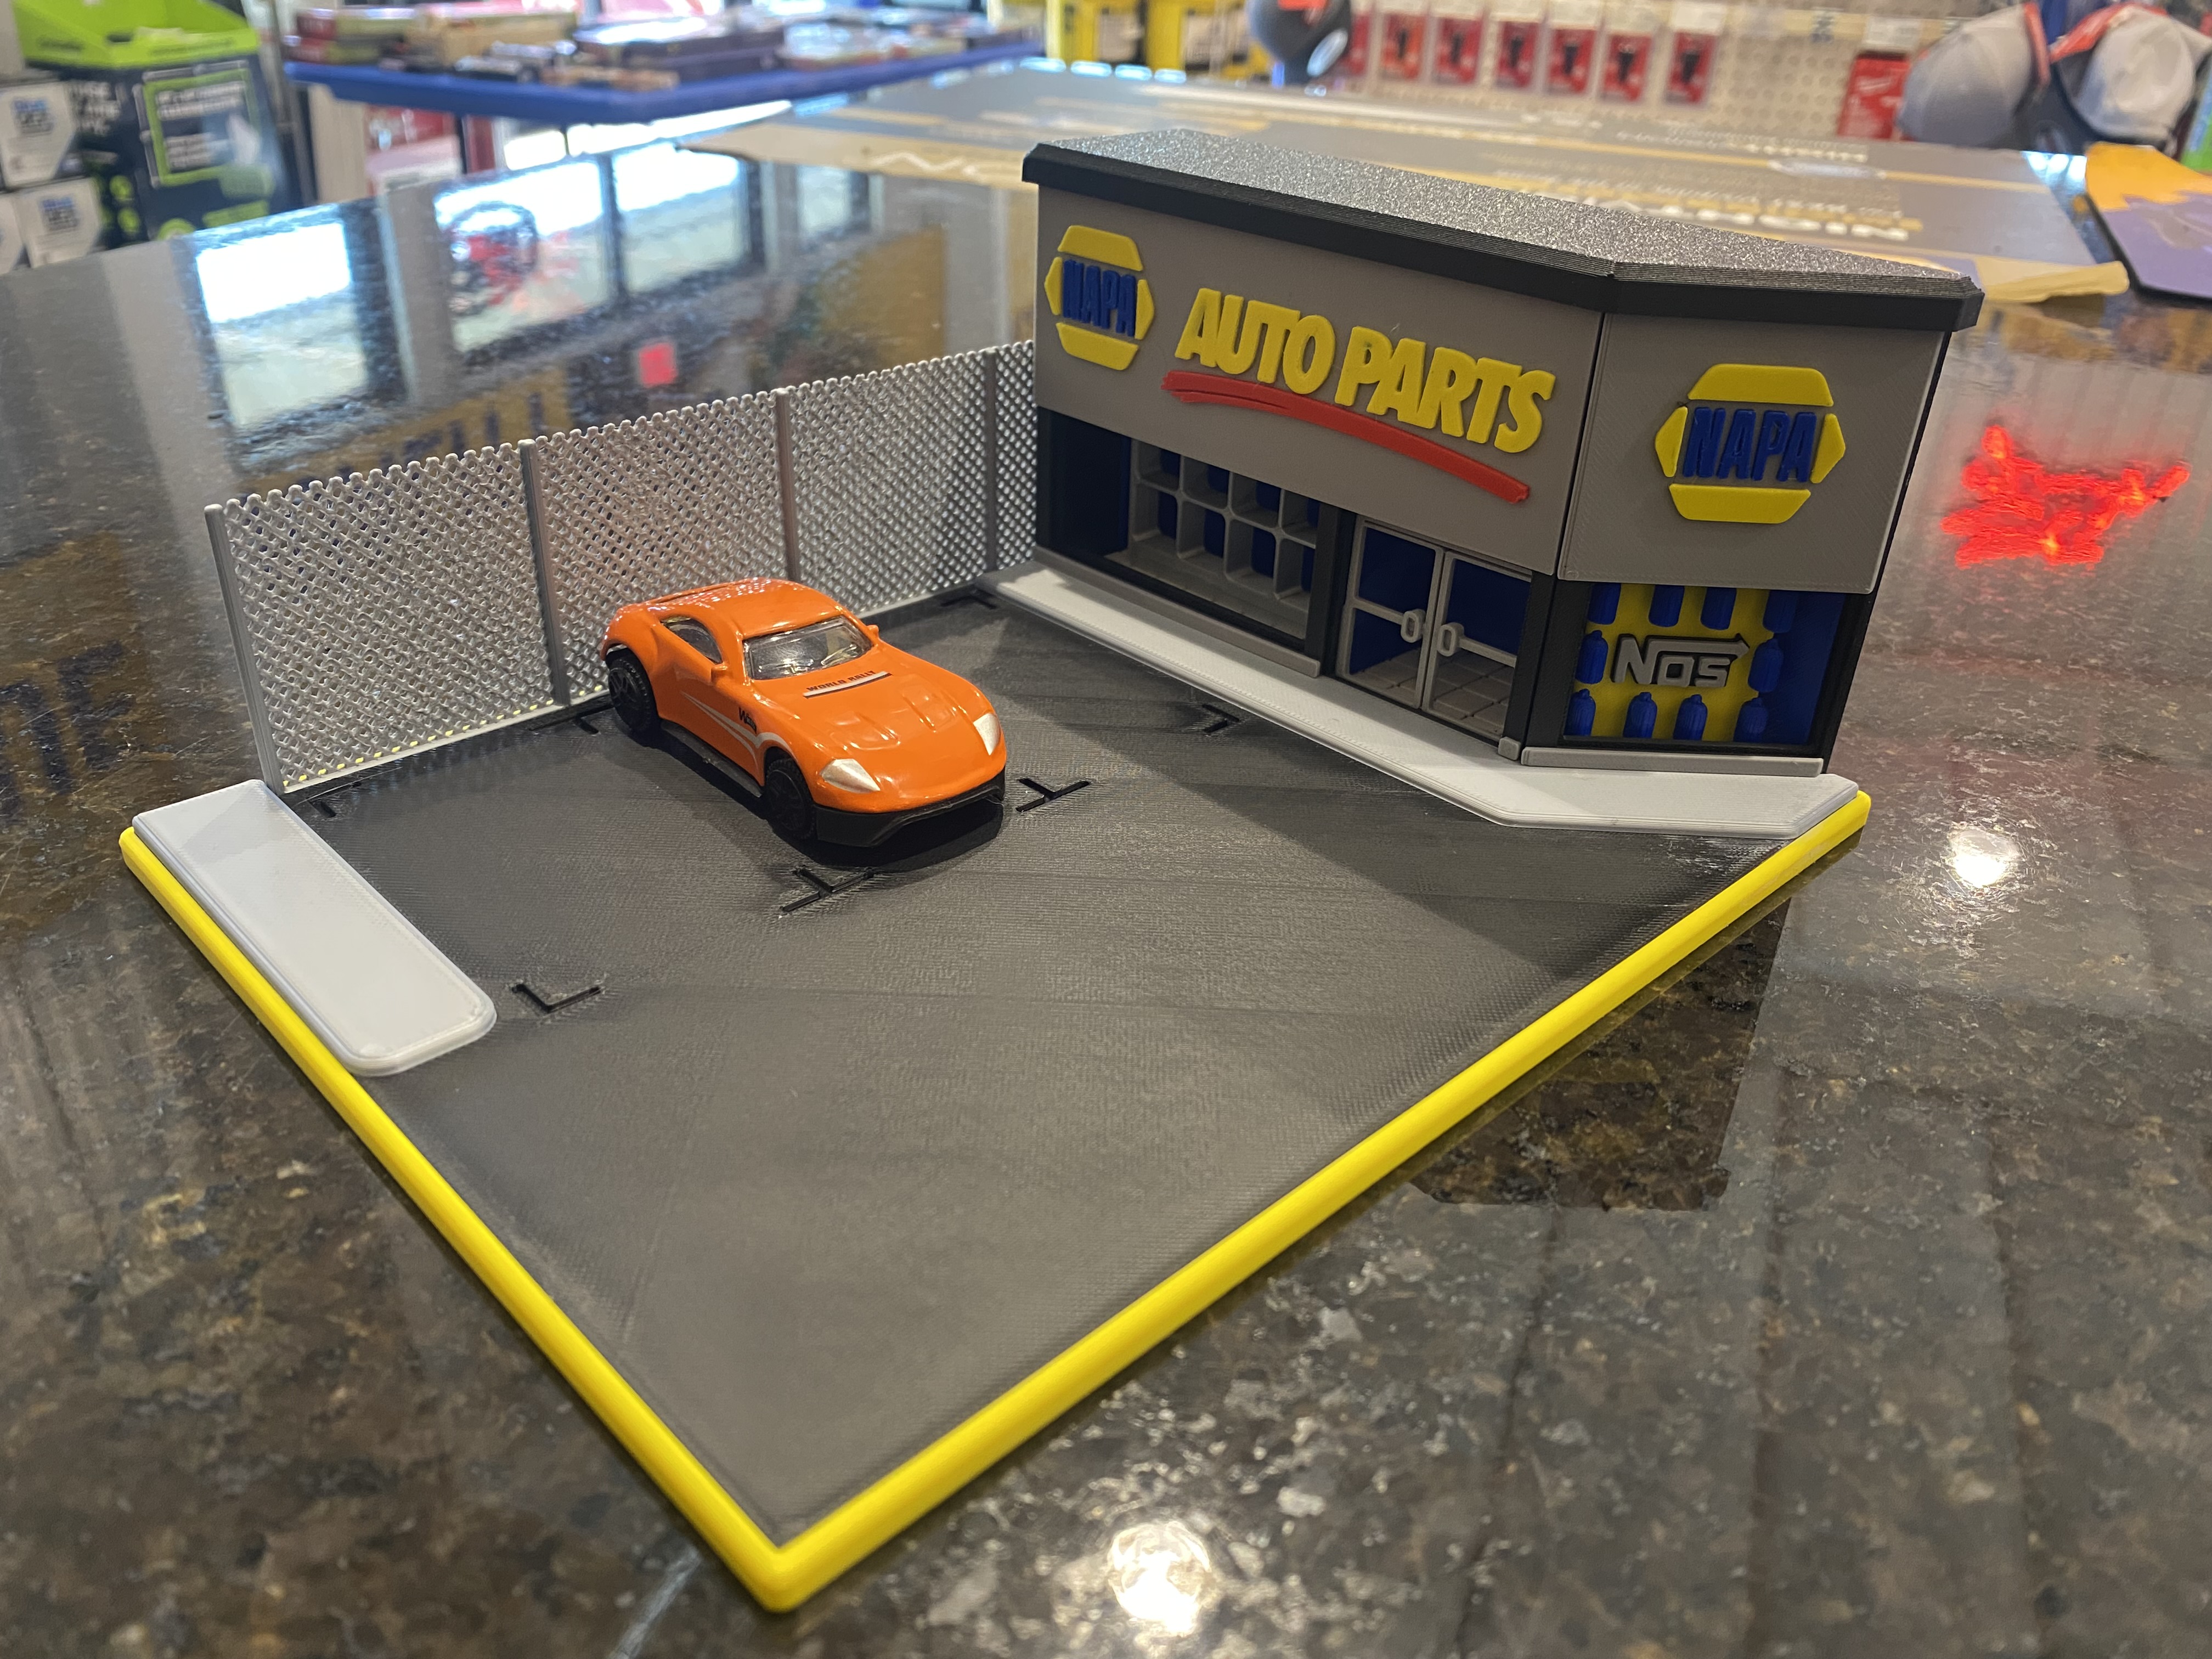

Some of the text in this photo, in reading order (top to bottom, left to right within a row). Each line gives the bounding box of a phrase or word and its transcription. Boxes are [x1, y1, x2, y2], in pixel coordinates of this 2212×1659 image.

[1063, 259, 1137, 338] NAPA
[1174, 287, 1556, 454] AUTO PARTS
[1682, 407, 1818, 483] NAPA
[806, 670, 877, 692] WORLD RALLY
[1610, 633, 1751, 688] NOS
